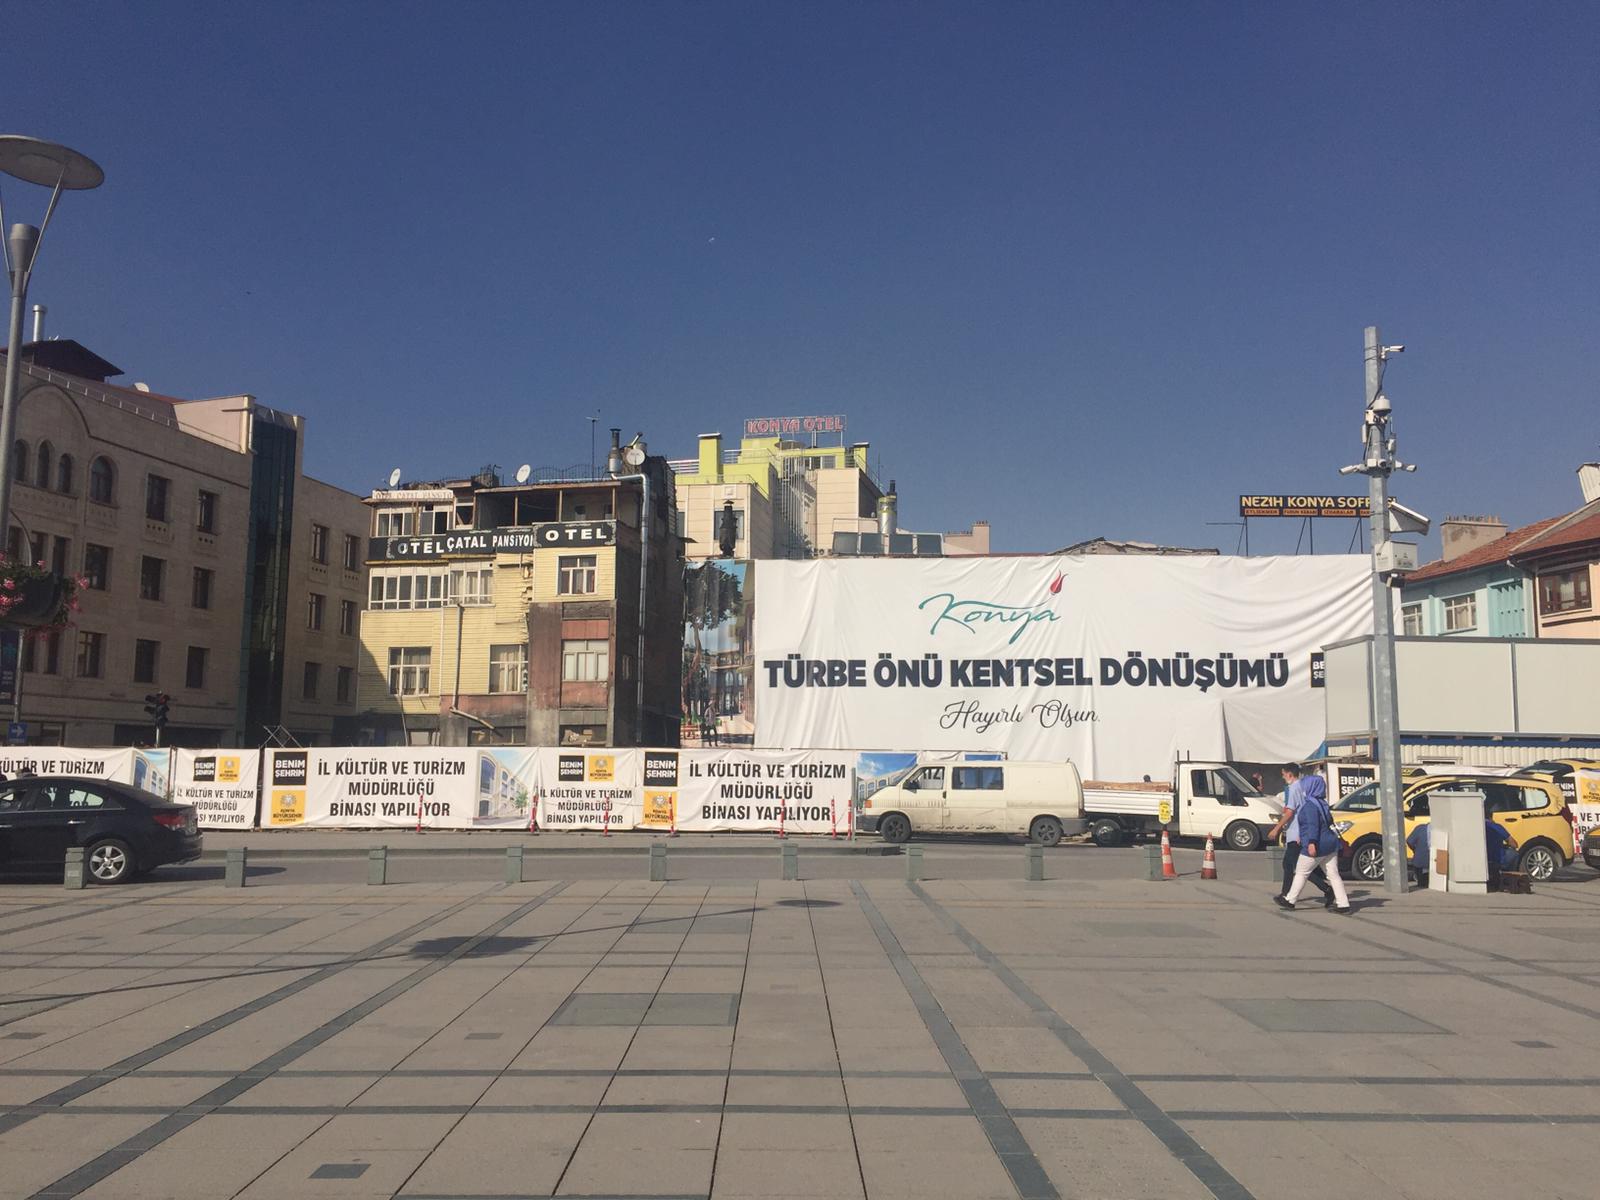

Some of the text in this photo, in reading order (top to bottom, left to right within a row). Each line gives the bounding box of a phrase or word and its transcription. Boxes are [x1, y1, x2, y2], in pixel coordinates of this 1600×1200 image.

[747, 416, 844, 433] KONYA OTEL
[1287, 496, 1335, 508] KONYA
[545, 528, 607, 541] OTEL
[397, 540, 445, 555] OTEL
[446, 533, 487, 553] ÇATAL
[918, 593, 1061, 645] Konya
[763, 651, 1290, 693] TÜRBE ÖNÜ KENTSEL DÖNÜŞÜMÜ
[939, 699, 1024, 734] Hayırlı
[0, 757, 105, 775] ÜLTÜR VE TURİZM
[274, 759, 306, 769] BENİM
[317, 757, 466, 776] İL KÜLTÜR VE TURİZM
[560, 761, 584, 769] BENİM
[646, 760, 677, 769] BENİM
[689, 759, 846, 778] İL KÜLTÜR VE TURİZM
[274, 768, 306, 778] ŞEHRİM
[560, 768, 583, 776] ŞEHRİM
[646, 769, 677, 779] ŞEHRİM
[185, 787, 213, 799] KÜLTÜR
[214, 789, 224, 799] VE
[226, 788, 254, 799] TURİZM
[348, 778, 435, 796] MÜDÜRLÜĞÜ
[539, 787, 548, 798] İL
[550, 787, 583, 799] KÜLTÜR
[585, 789, 596, 799] VE
[720, 780, 814, 800] MÜDÜRLÜĞÜ
[329, 799, 377, 817] BİNASI
[557, 799, 614, 811] MÜDÜRLÜĞÜ
[701, 801, 831, 821] BİNASI YAPILIYOR
[208, 813, 245, 824] YAPILIYOR
[546, 812, 577, 824] BİNASI
